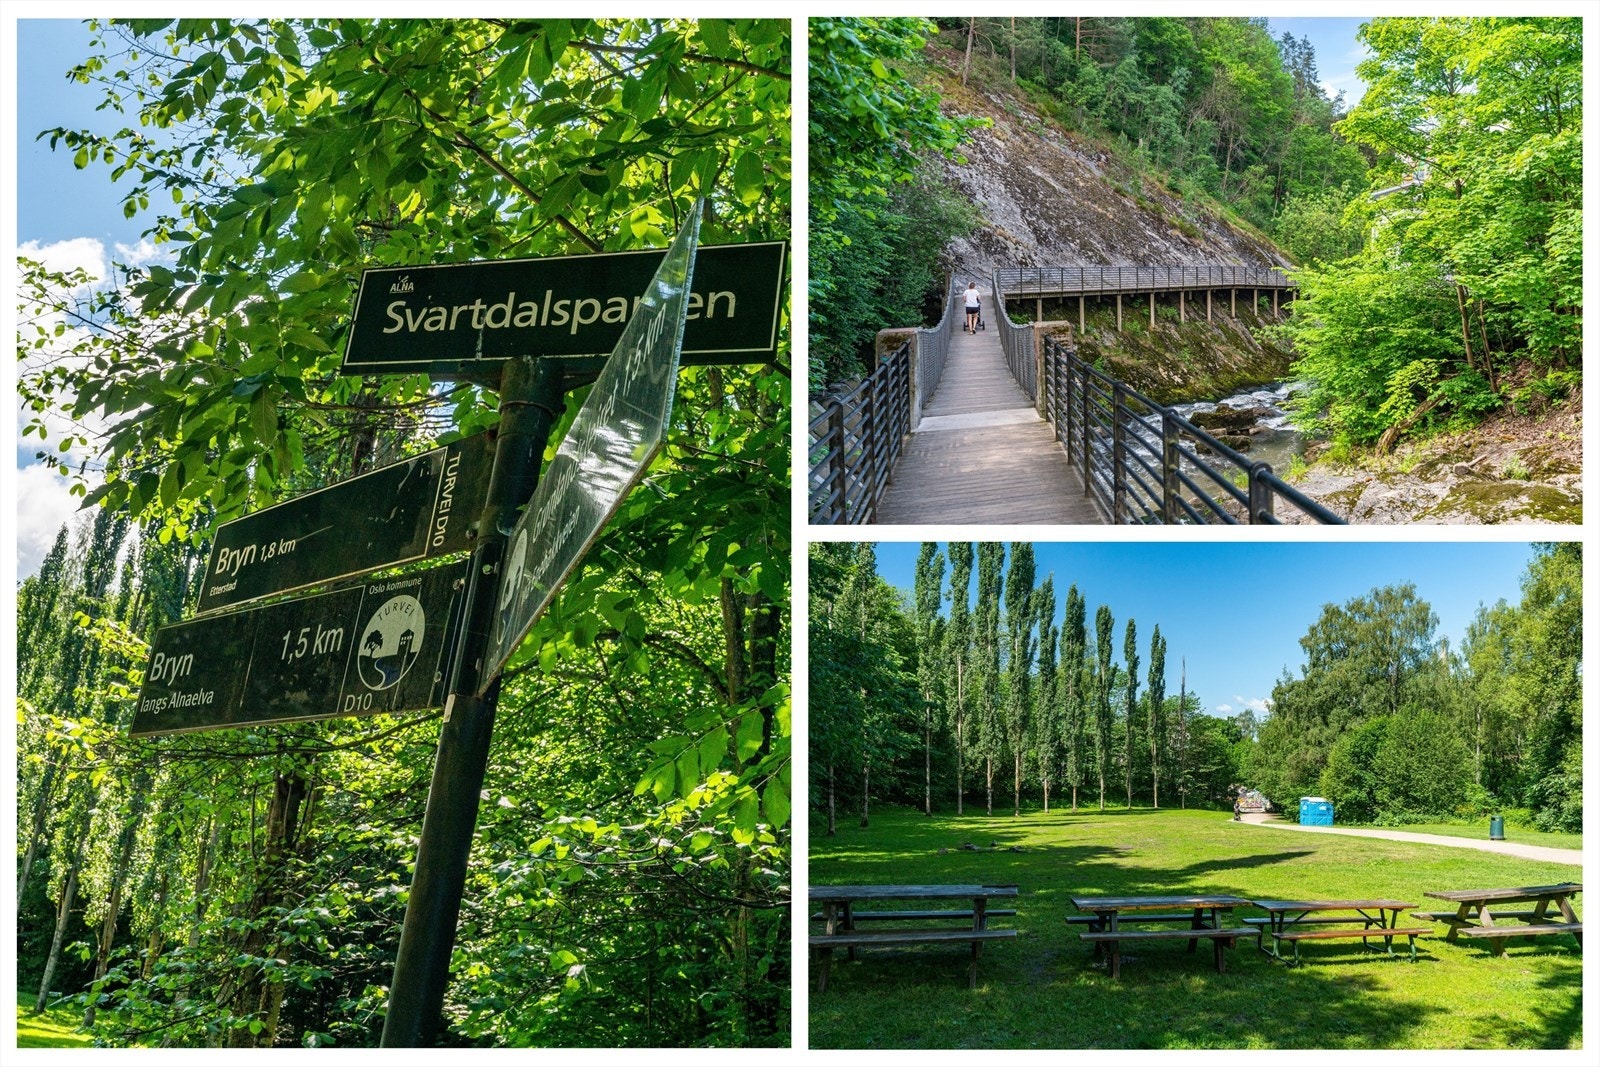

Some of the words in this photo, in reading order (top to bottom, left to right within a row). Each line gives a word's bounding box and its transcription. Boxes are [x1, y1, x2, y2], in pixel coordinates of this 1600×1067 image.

[382, 289, 737, 334] Svartdalspaen
[642, 302, 667, 363] km
[438, 451, 462, 514] TURVEI
[432, 515, 449, 547] D10
[215, 544, 257, 577] Bryn
[260, 542, 277, 563] 1,8
[277, 538, 297, 556] km
[368, 583, 386, 595] Oslo
[385, 577, 423, 592] kommune
[376, 601, 415, 621] TURVEI
[281, 627, 311, 665] 1,5
[311, 623, 344, 656] km
[149, 652, 194, 687] Bryn
[140, 696, 168, 715] langs
[167, 688, 215, 709] Alnaelva
[343, 692, 373, 713] D10
